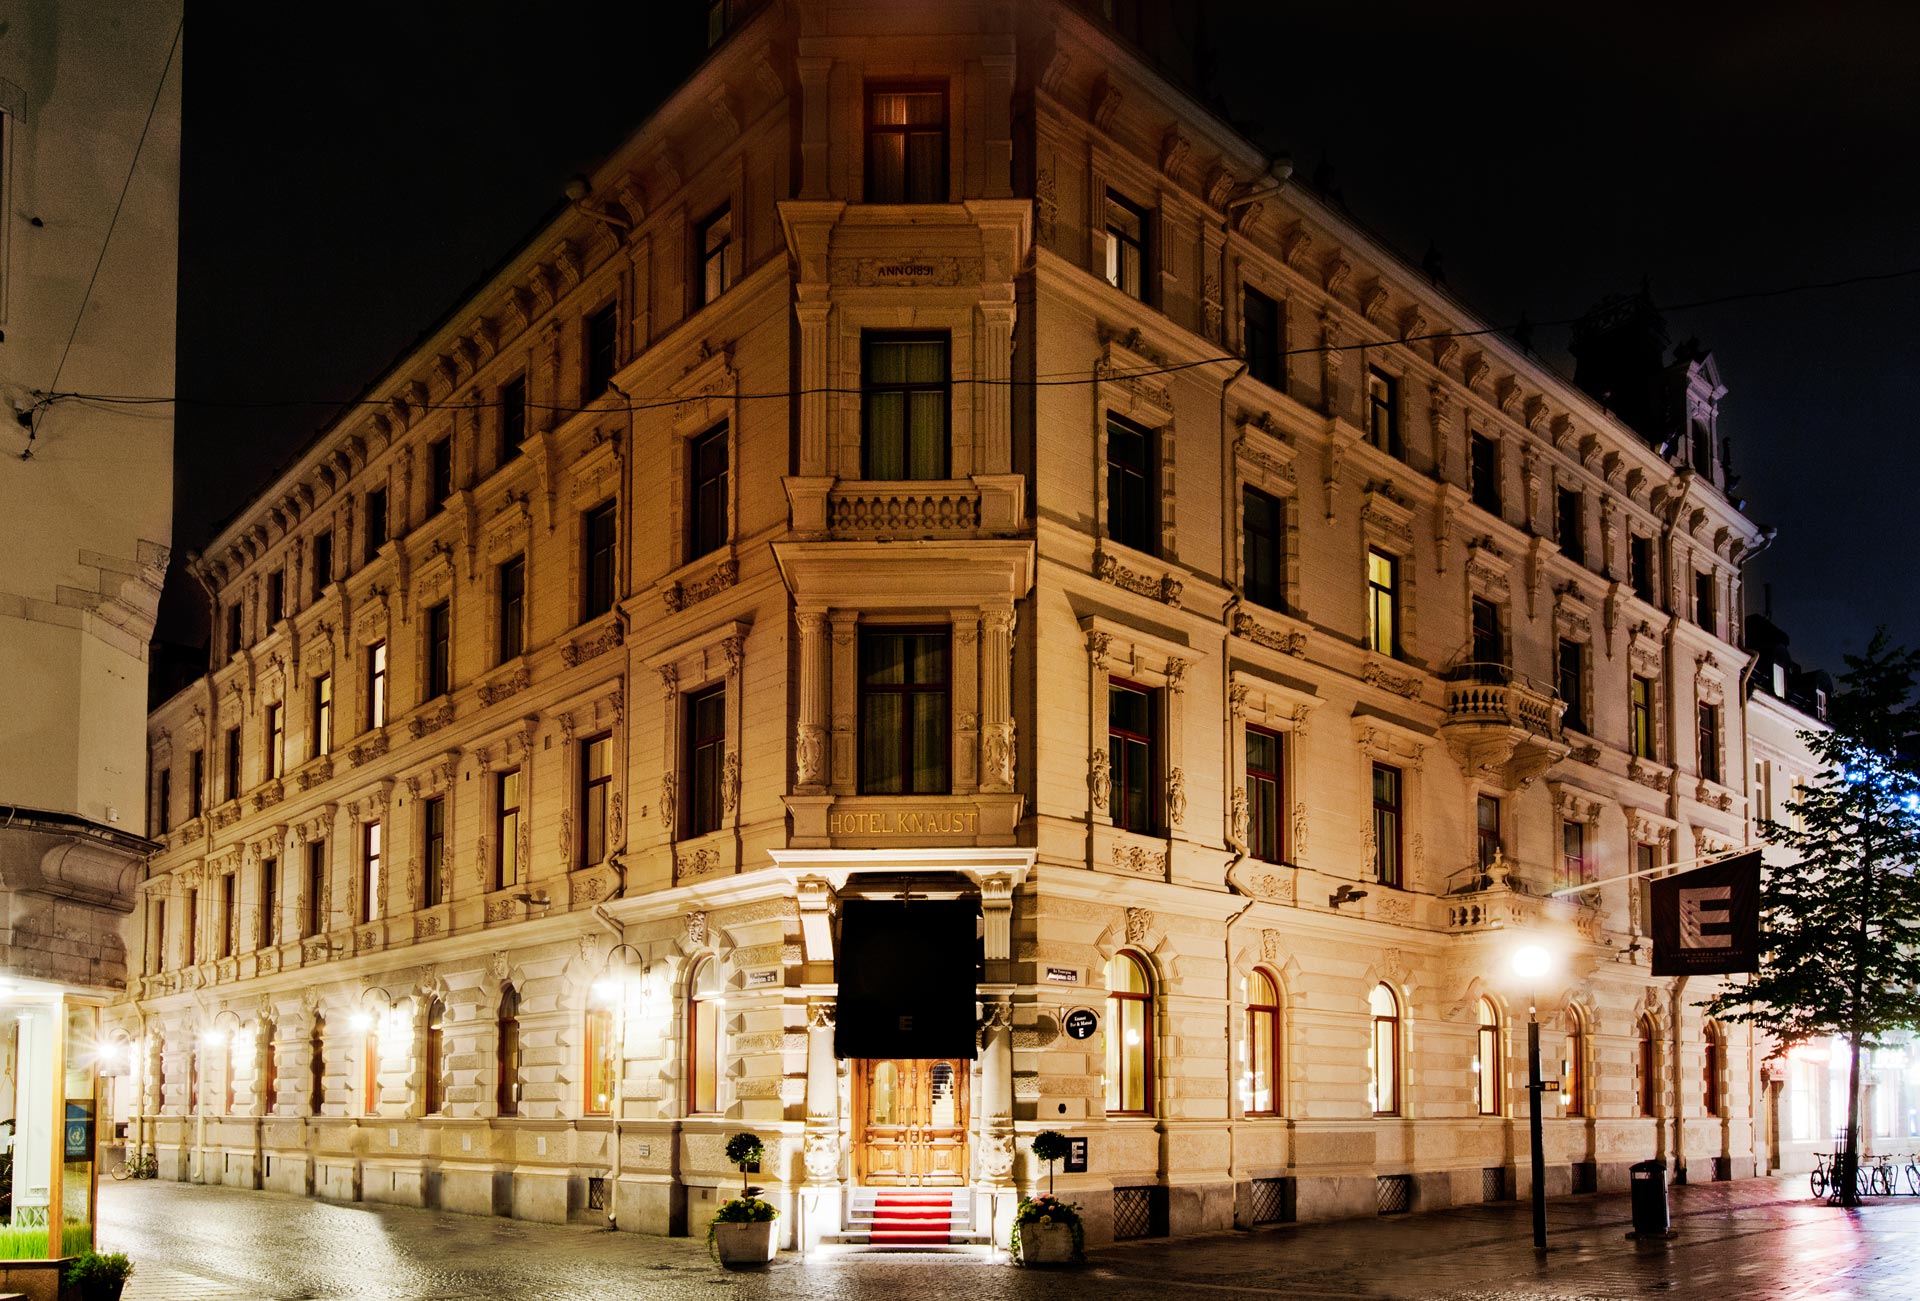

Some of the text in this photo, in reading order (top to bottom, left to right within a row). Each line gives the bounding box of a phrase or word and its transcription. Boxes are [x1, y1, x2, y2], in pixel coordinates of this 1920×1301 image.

[830, 813, 978, 833] HOTEL KNAUST
[1679, 886, 1731, 948] E
[1079, 1028, 1084, 1037] E
[1071, 1141, 1084, 1163] E
